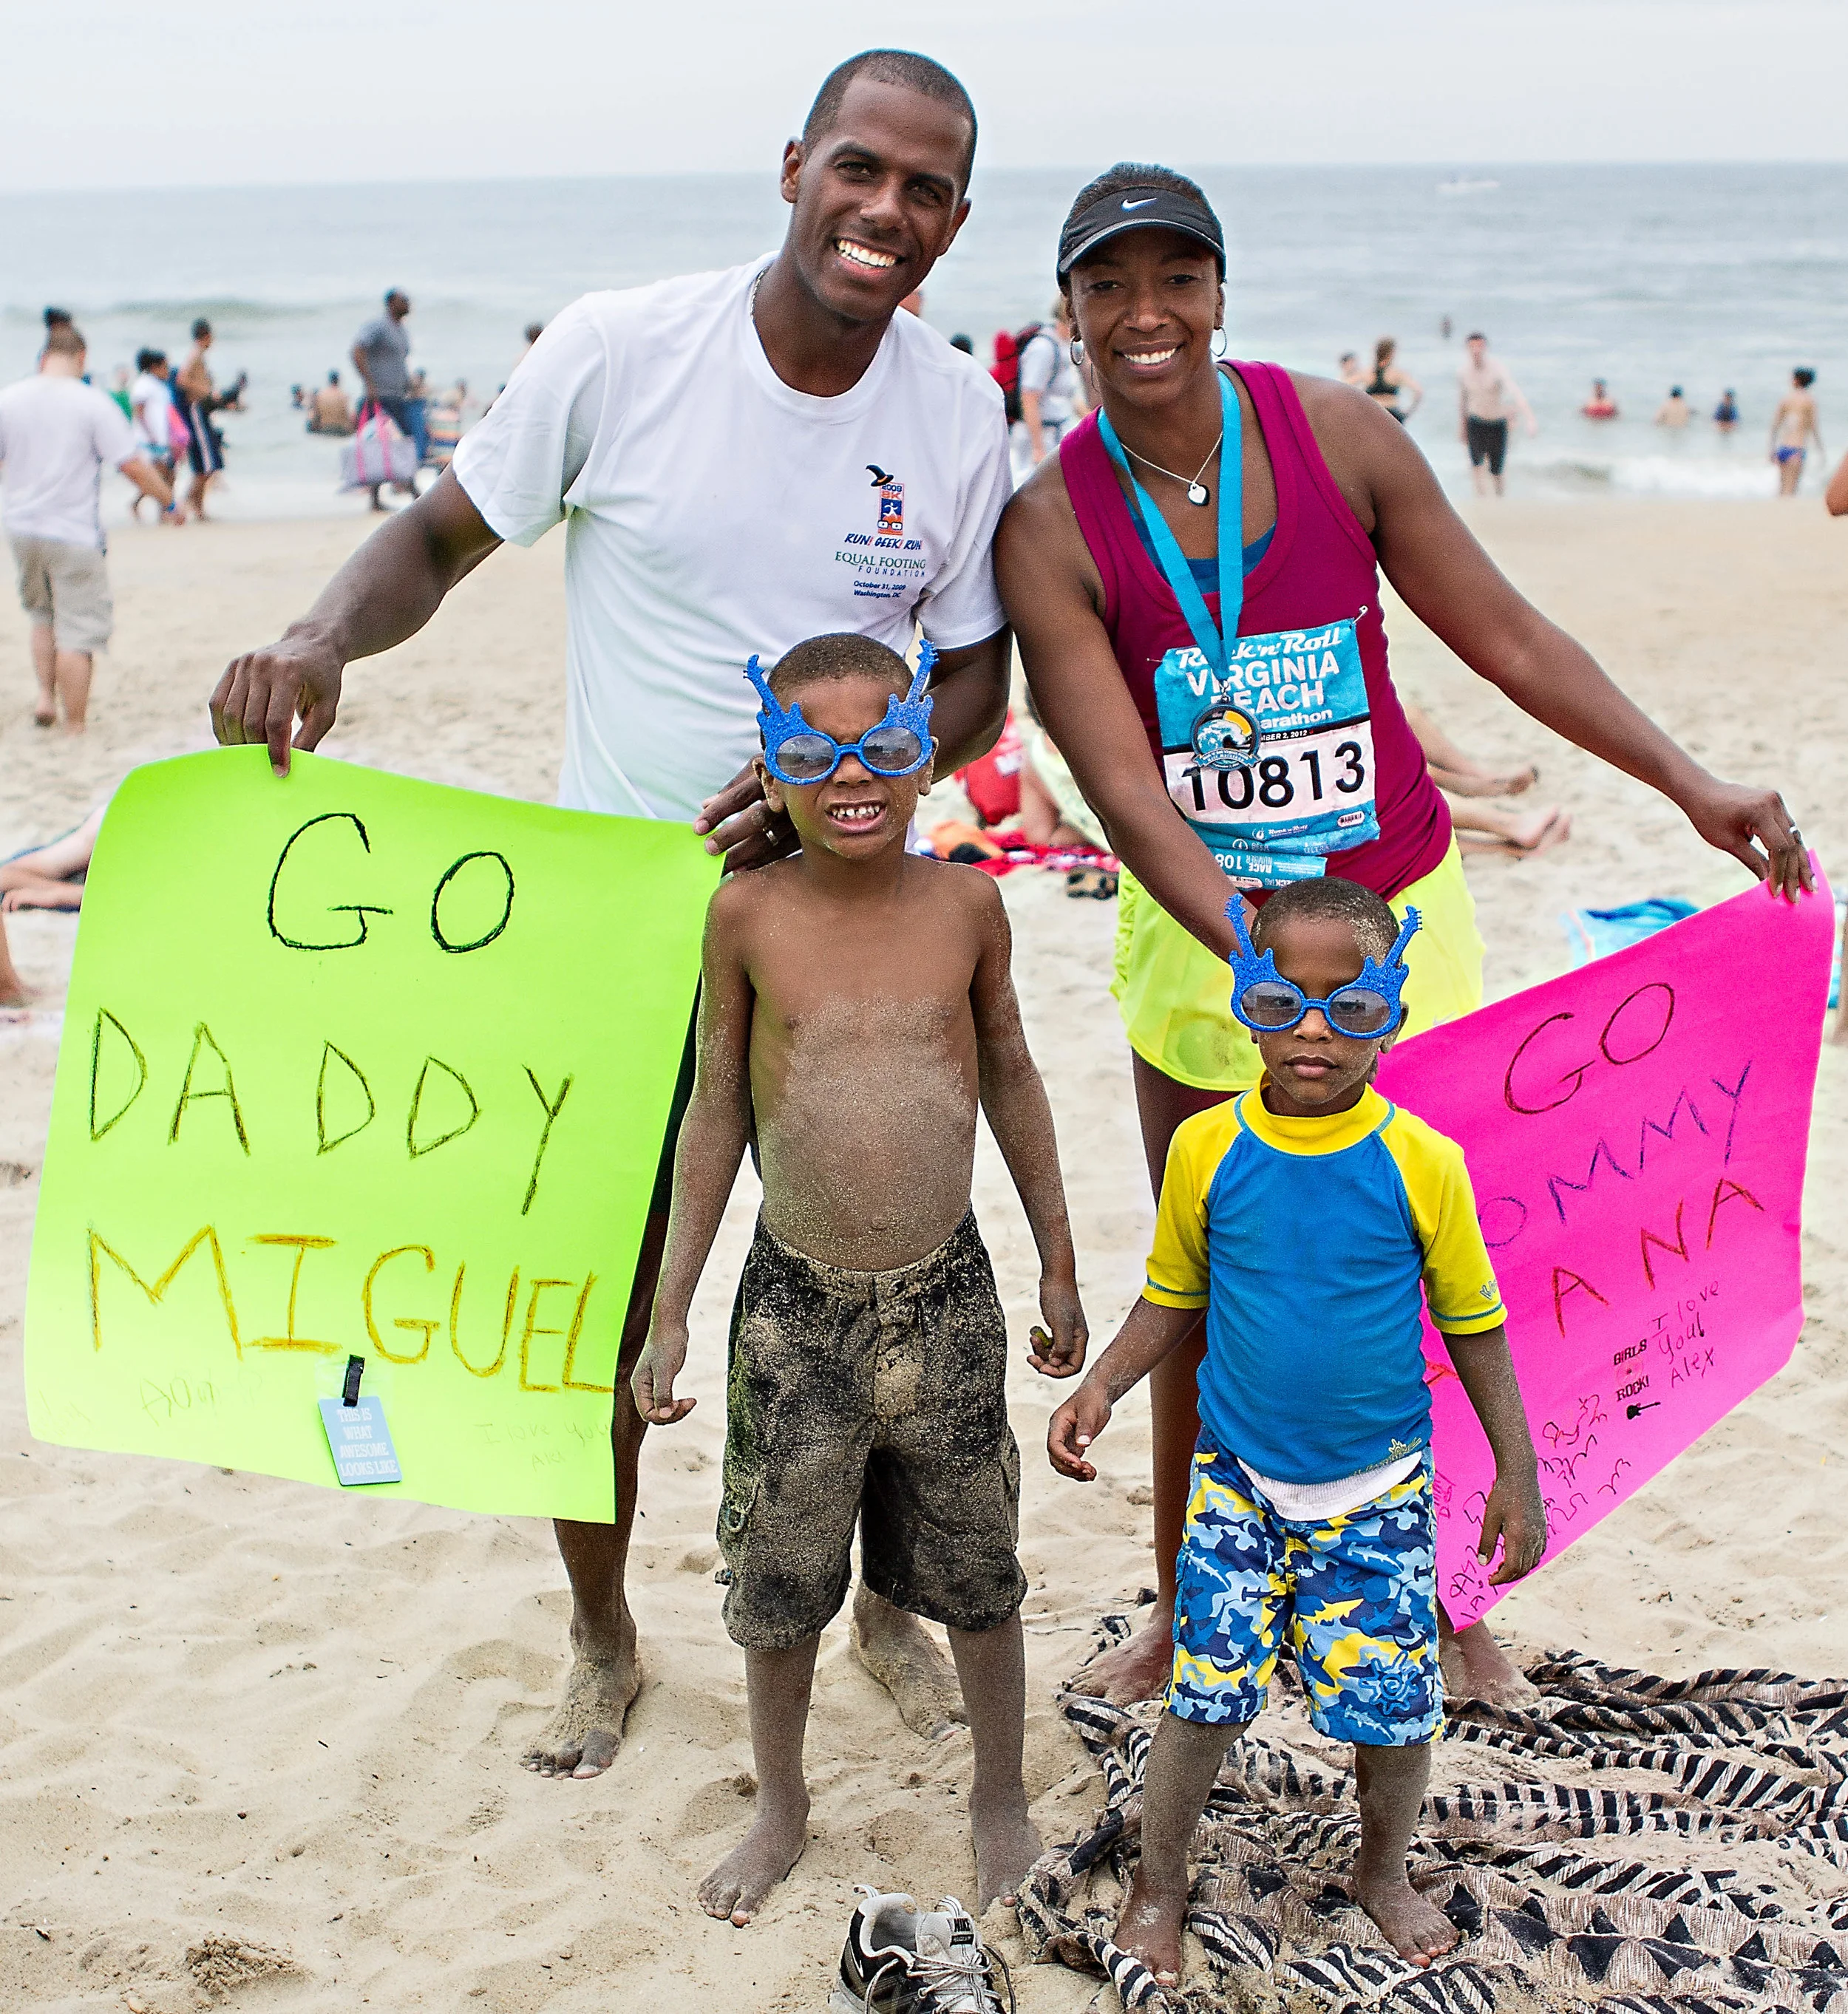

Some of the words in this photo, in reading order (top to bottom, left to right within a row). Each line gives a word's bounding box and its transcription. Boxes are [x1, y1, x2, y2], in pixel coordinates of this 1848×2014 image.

[835, 551, 876, 566] EQUAL
[879, 557, 926, 569] FOOTING
[858, 565, 925, 577] FOUNDATION
[853, 580, 880, 588] October
[1175, 642, 1257, 669] Rk
[1280, 627, 1342, 654] Roll
[1210, 681, 1325, 715] EACH
[1260, 710, 1333, 729] arathon
[1289, 730, 1308, 738] 2012
[1181, 741, 1365, 812] 10813
[267, 812, 517, 953] GO
[1504, 982, 1676, 1115] GO
[88, 1007, 574, 1216] DADDY
[1478, 1059, 1753, 1248] OMMY
[87, 1222, 614, 1393] MIGUEL
[336, 1408, 360, 1423] THIS
[361, 1407, 373, 1421] IS
[343, 1425, 373, 1440] WHAT
[340, 1442, 390, 1459] AWESOME
[340, 1462, 374, 1477] LOOKS
[374, 1459, 398, 1475] LIKE
